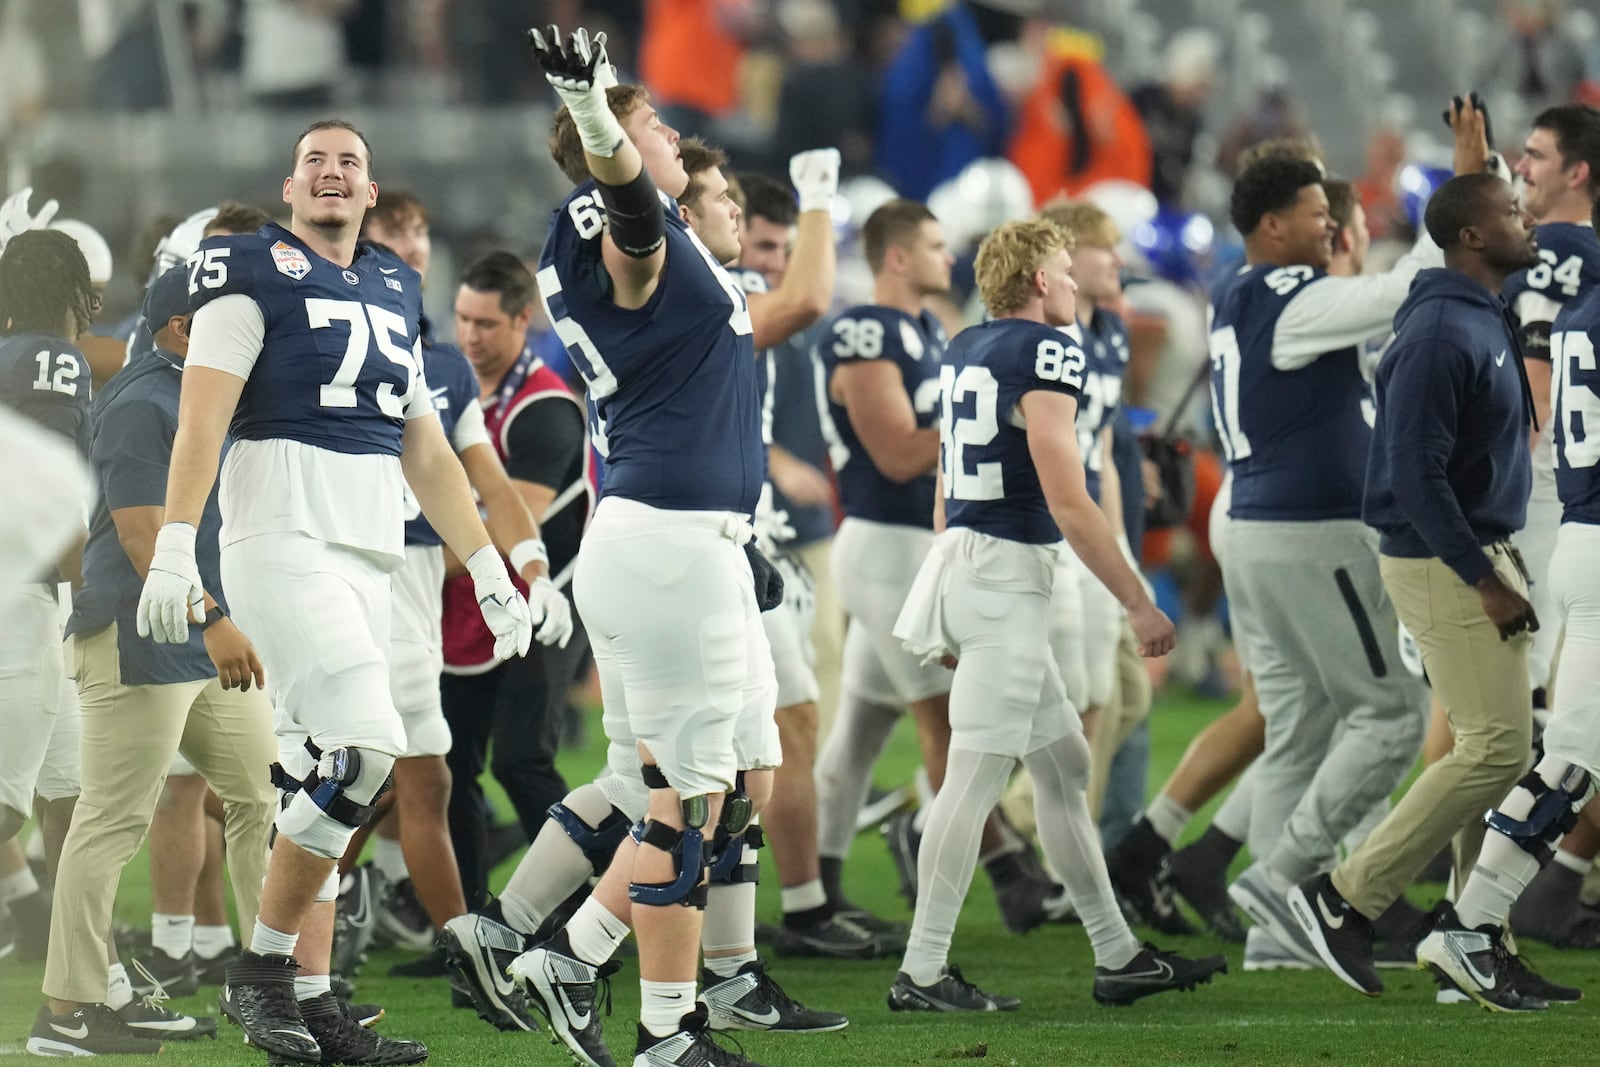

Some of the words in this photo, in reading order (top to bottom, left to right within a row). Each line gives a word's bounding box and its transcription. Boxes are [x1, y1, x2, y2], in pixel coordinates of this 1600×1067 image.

[187, 247, 231, 296] 75
[1526, 248, 1583, 297] 64
[304, 298, 420, 420] 75
[833, 317, 885, 359] 38
[33, 350, 80, 397] 12
[1035, 339, 1086, 390] 82
